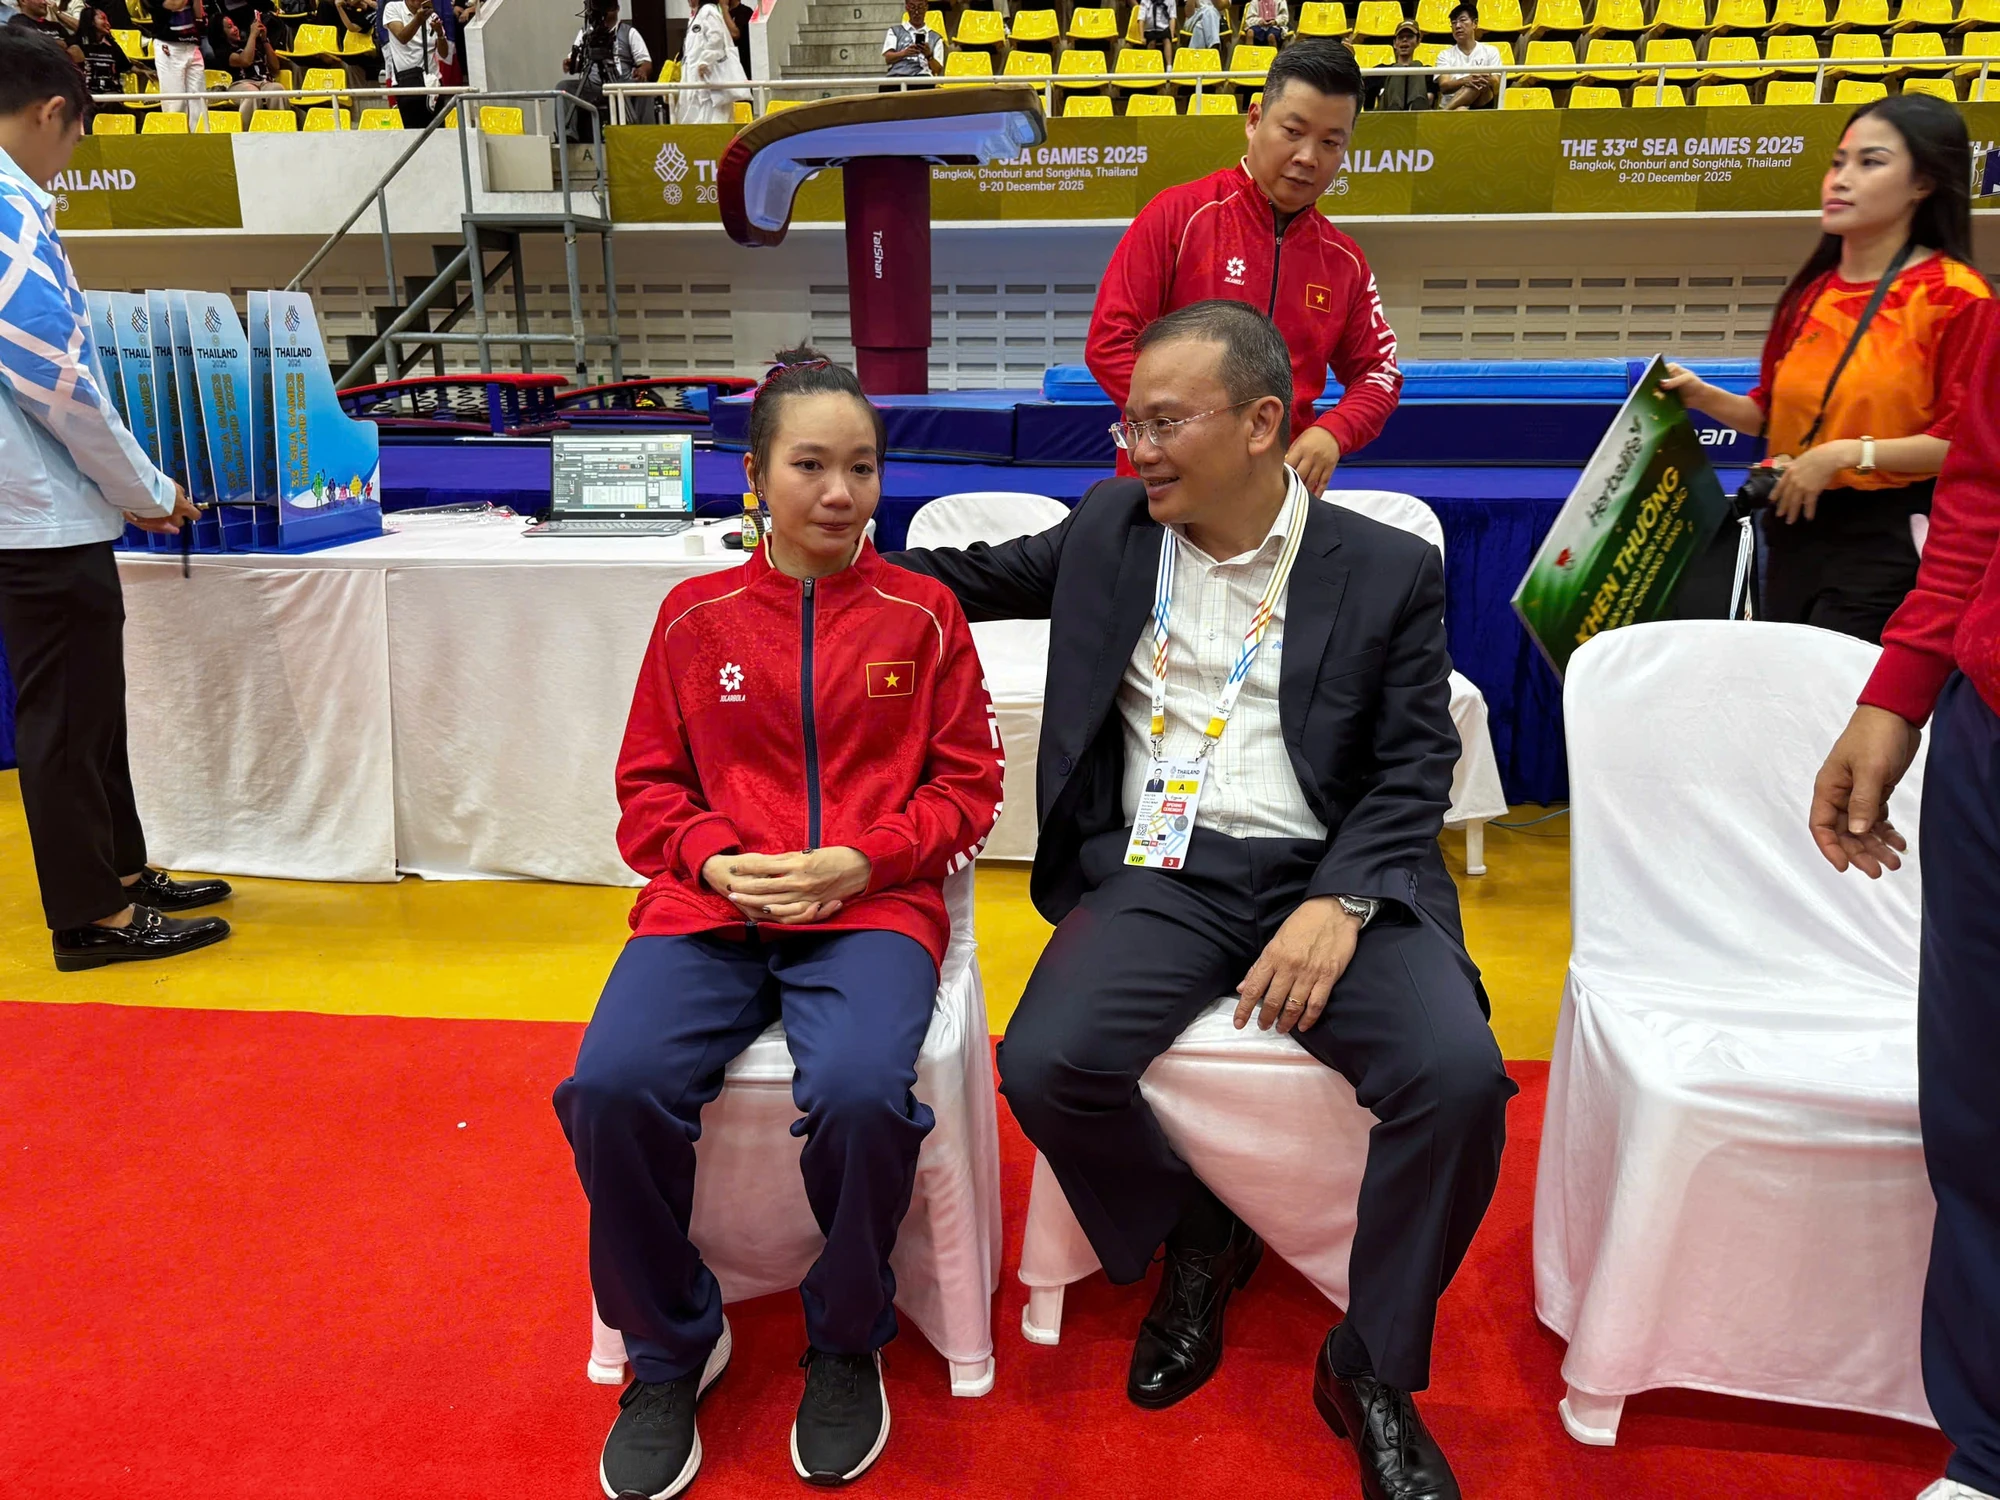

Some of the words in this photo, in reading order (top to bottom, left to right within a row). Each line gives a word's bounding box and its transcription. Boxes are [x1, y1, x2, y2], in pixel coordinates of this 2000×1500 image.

[853, 8, 862, 19] D
[839, 49, 848, 60] C
[1560, 139, 1597, 157] THE
[1602, 137, 1637, 156] 33rd
[1642, 137, 1678, 156] SEA
[1684, 137, 1750, 155] GAMES
[1755, 136, 1804, 154] 2025
[582, 148, 593, 161] A
[1036, 147, 1098, 165] GAMES
[1103, 146, 1148, 164] 2025
[1569, 159, 1616, 171] Bangkok,
[1619, 159, 1666, 170] Chonburi
[1669, 158, 1688, 169] and
[1692, 158, 1743, 171] Songkhla,
[1746, 157, 1791, 168] Thailand
[932, 168, 976, 180] Bangkok,
[978, 168, 1022, 179] Chonburi
[1024, 167, 1043, 178] and
[1046, 167, 1093, 179] Songkhla,
[1096, 166, 1138, 177] Thailand
[1619, 173, 1645, 183] 9-20
[1648, 172, 1700, 182] December
[1704, 171, 1731, 182] 2025
[979, 182, 1003, 192] 9-20
[1006, 181, 1055, 191] December
[1058, 180, 1084, 190] 2025
[873, 230, 884, 279] TaiShan
[197, 348, 238, 359] THAILAND
[275, 347, 312, 358] THAILAND
[296, 372, 306, 410] 2025
[211, 373, 228, 429] GAMES
[286, 372, 297, 428] GAMES
[1694, 428, 1737, 446] an
[289, 432, 298, 461] SEA
[299, 414, 310, 487] THAILAND
[1179, 783, 1185, 791] A
[1131, 855, 1144, 863] VIP
[1168, 858, 1174, 866] 3
